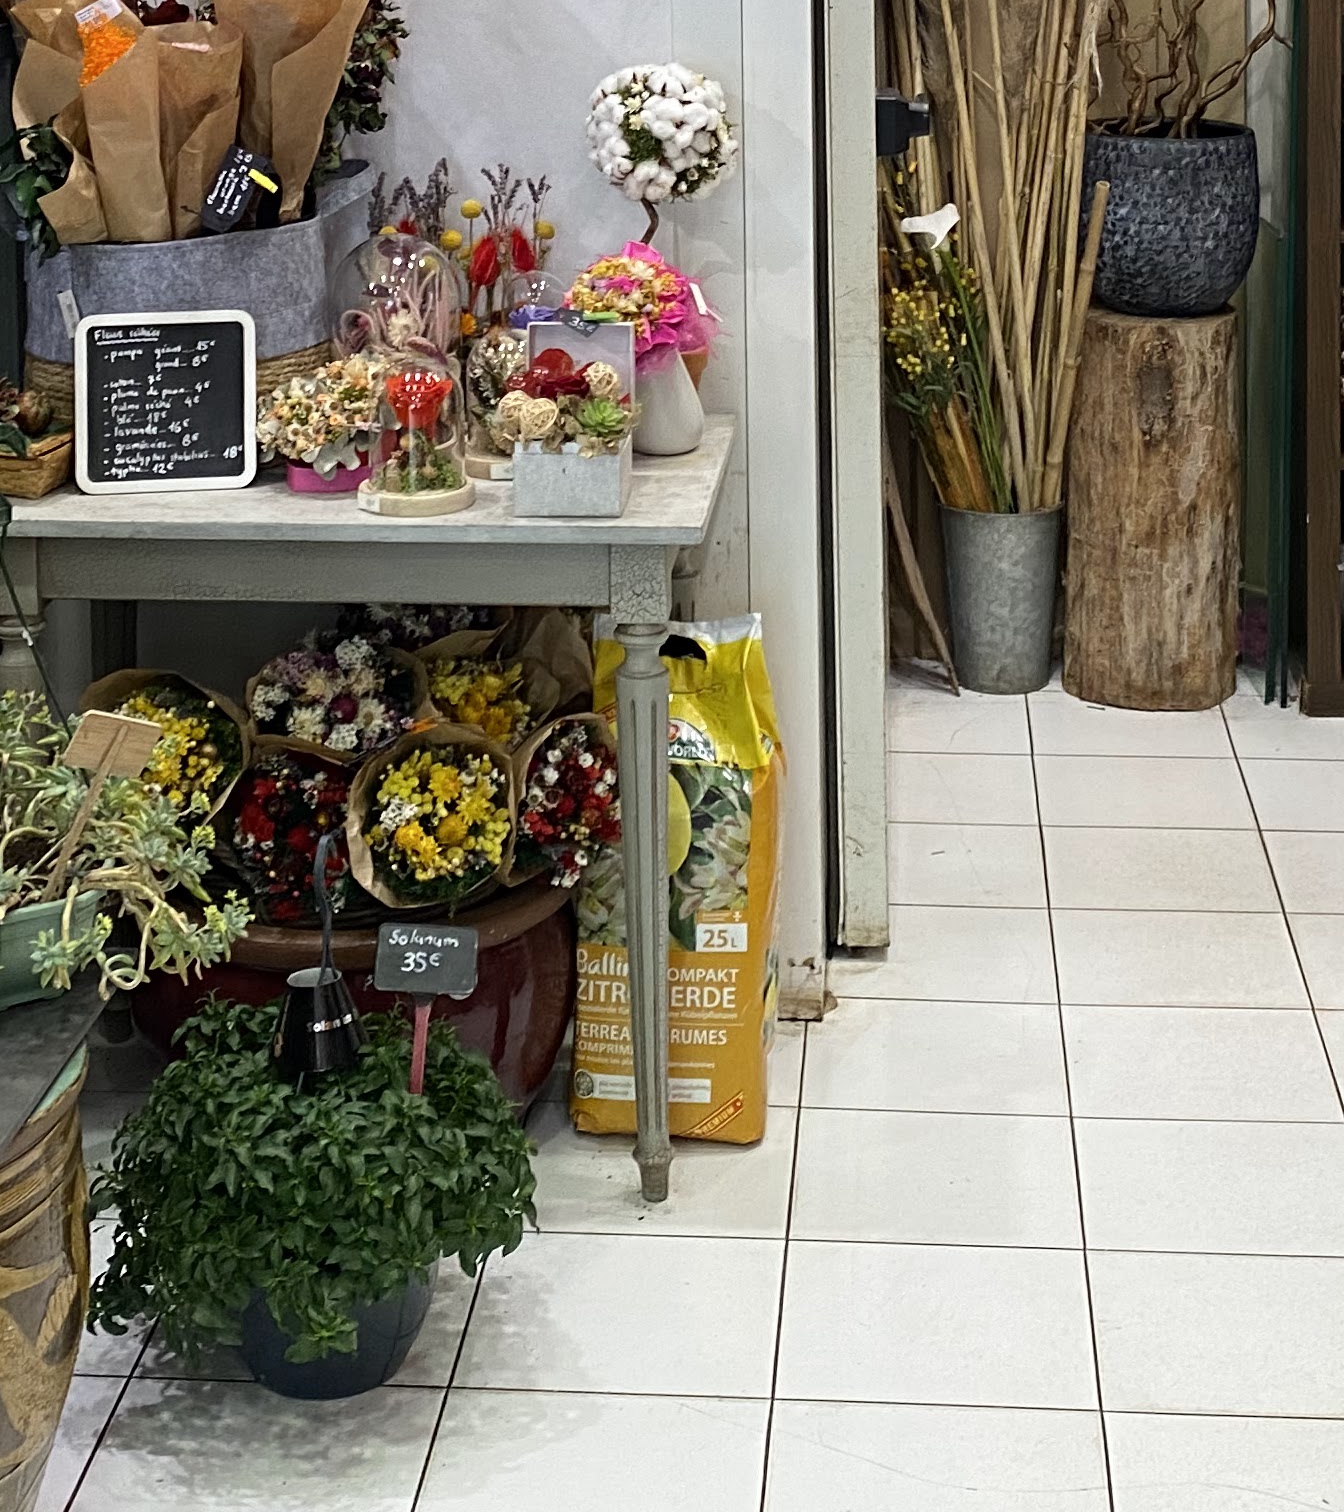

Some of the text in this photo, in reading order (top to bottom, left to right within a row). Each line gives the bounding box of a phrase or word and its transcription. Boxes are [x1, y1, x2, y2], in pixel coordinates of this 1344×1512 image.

[152, 462, 175, 475] 12€
[388, 929, 460, 948] Solanum
[400, 951, 442, 973] 35€
